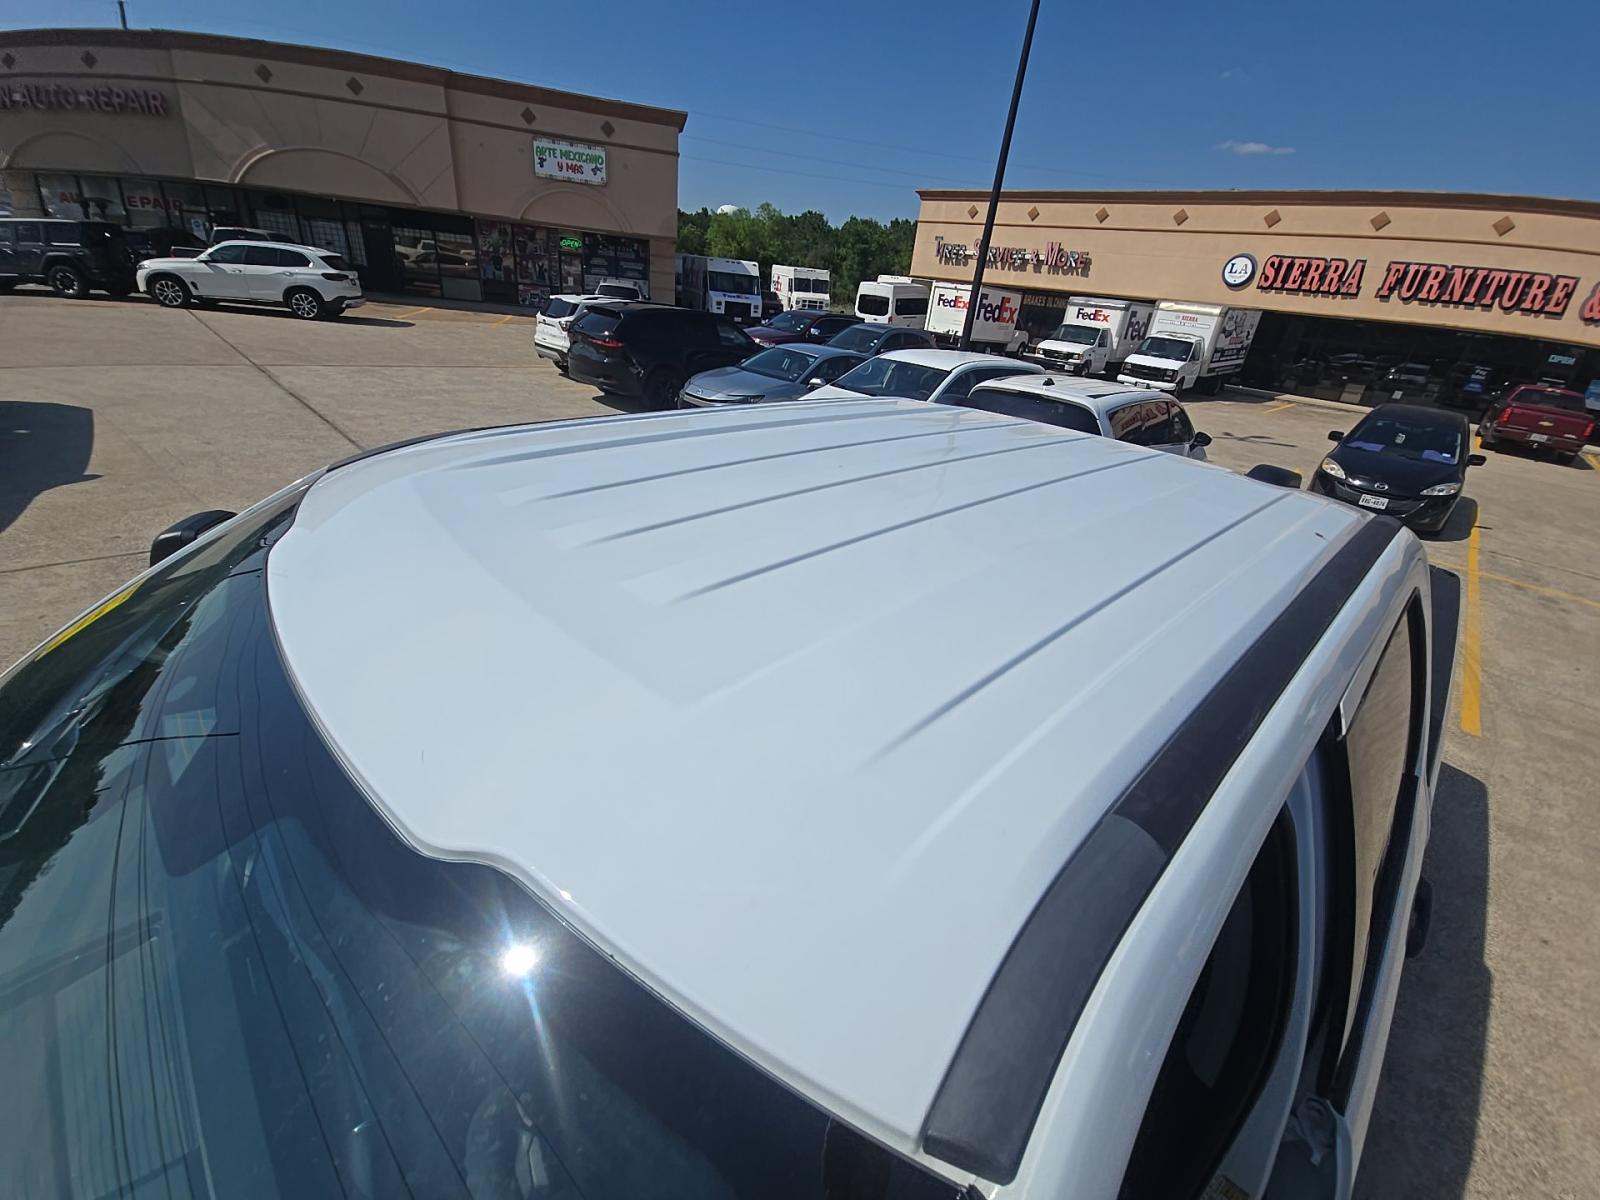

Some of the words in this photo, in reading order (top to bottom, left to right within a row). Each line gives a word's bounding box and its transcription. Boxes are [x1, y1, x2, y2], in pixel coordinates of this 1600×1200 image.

[23, 84, 75, 111] AUTO
[83, 86, 166, 116] REPAIR
[535, 145, 558, 158] ARTE
[559, 149, 604, 165] MEXICANO
[557, 161, 564, 172] Y
[566, 162, 585, 175] MAS
[126, 194, 184, 211] EPAIR
[560, 238, 581, 250] OPEN
[972, 238, 1027, 265] SRVICE
[1029, 248, 1039, 264] &
[1044, 241, 1090, 270] MORE
[1257, 255, 1367, 296] SIERRA
[1376, 261, 1580, 316] FURNITURE
[938, 293, 970, 309] FedEx
[976, 293, 1018, 324] FedEx
[1076, 307, 1110, 323] FedEx
[1125, 310, 1151, 341] Fed
